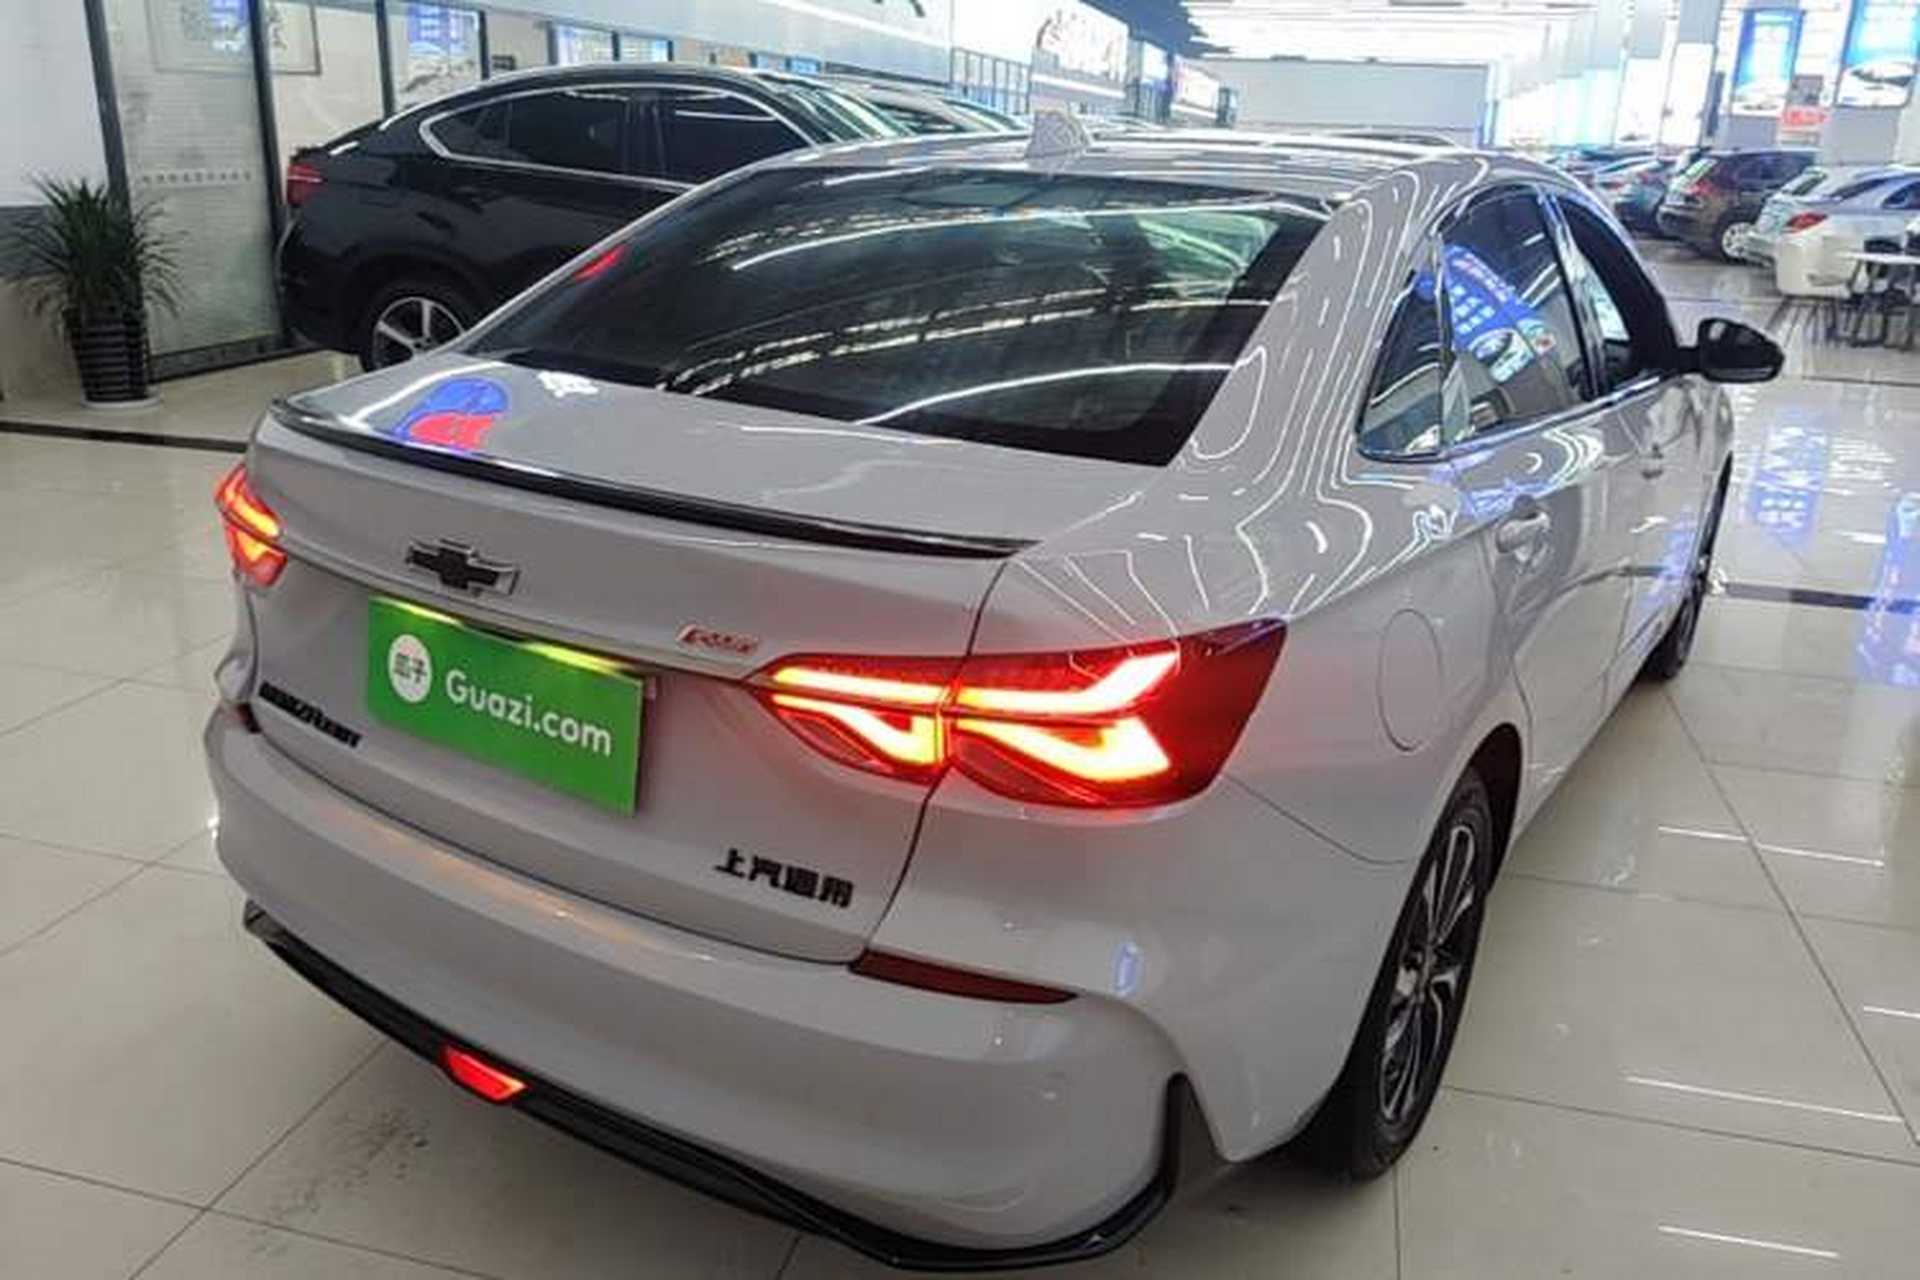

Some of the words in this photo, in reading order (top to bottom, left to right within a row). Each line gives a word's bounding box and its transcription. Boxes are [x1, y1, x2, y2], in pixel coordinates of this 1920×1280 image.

[446, 668, 612, 756] Guazi.com
[714, 848, 854, 908] 上汽通用
